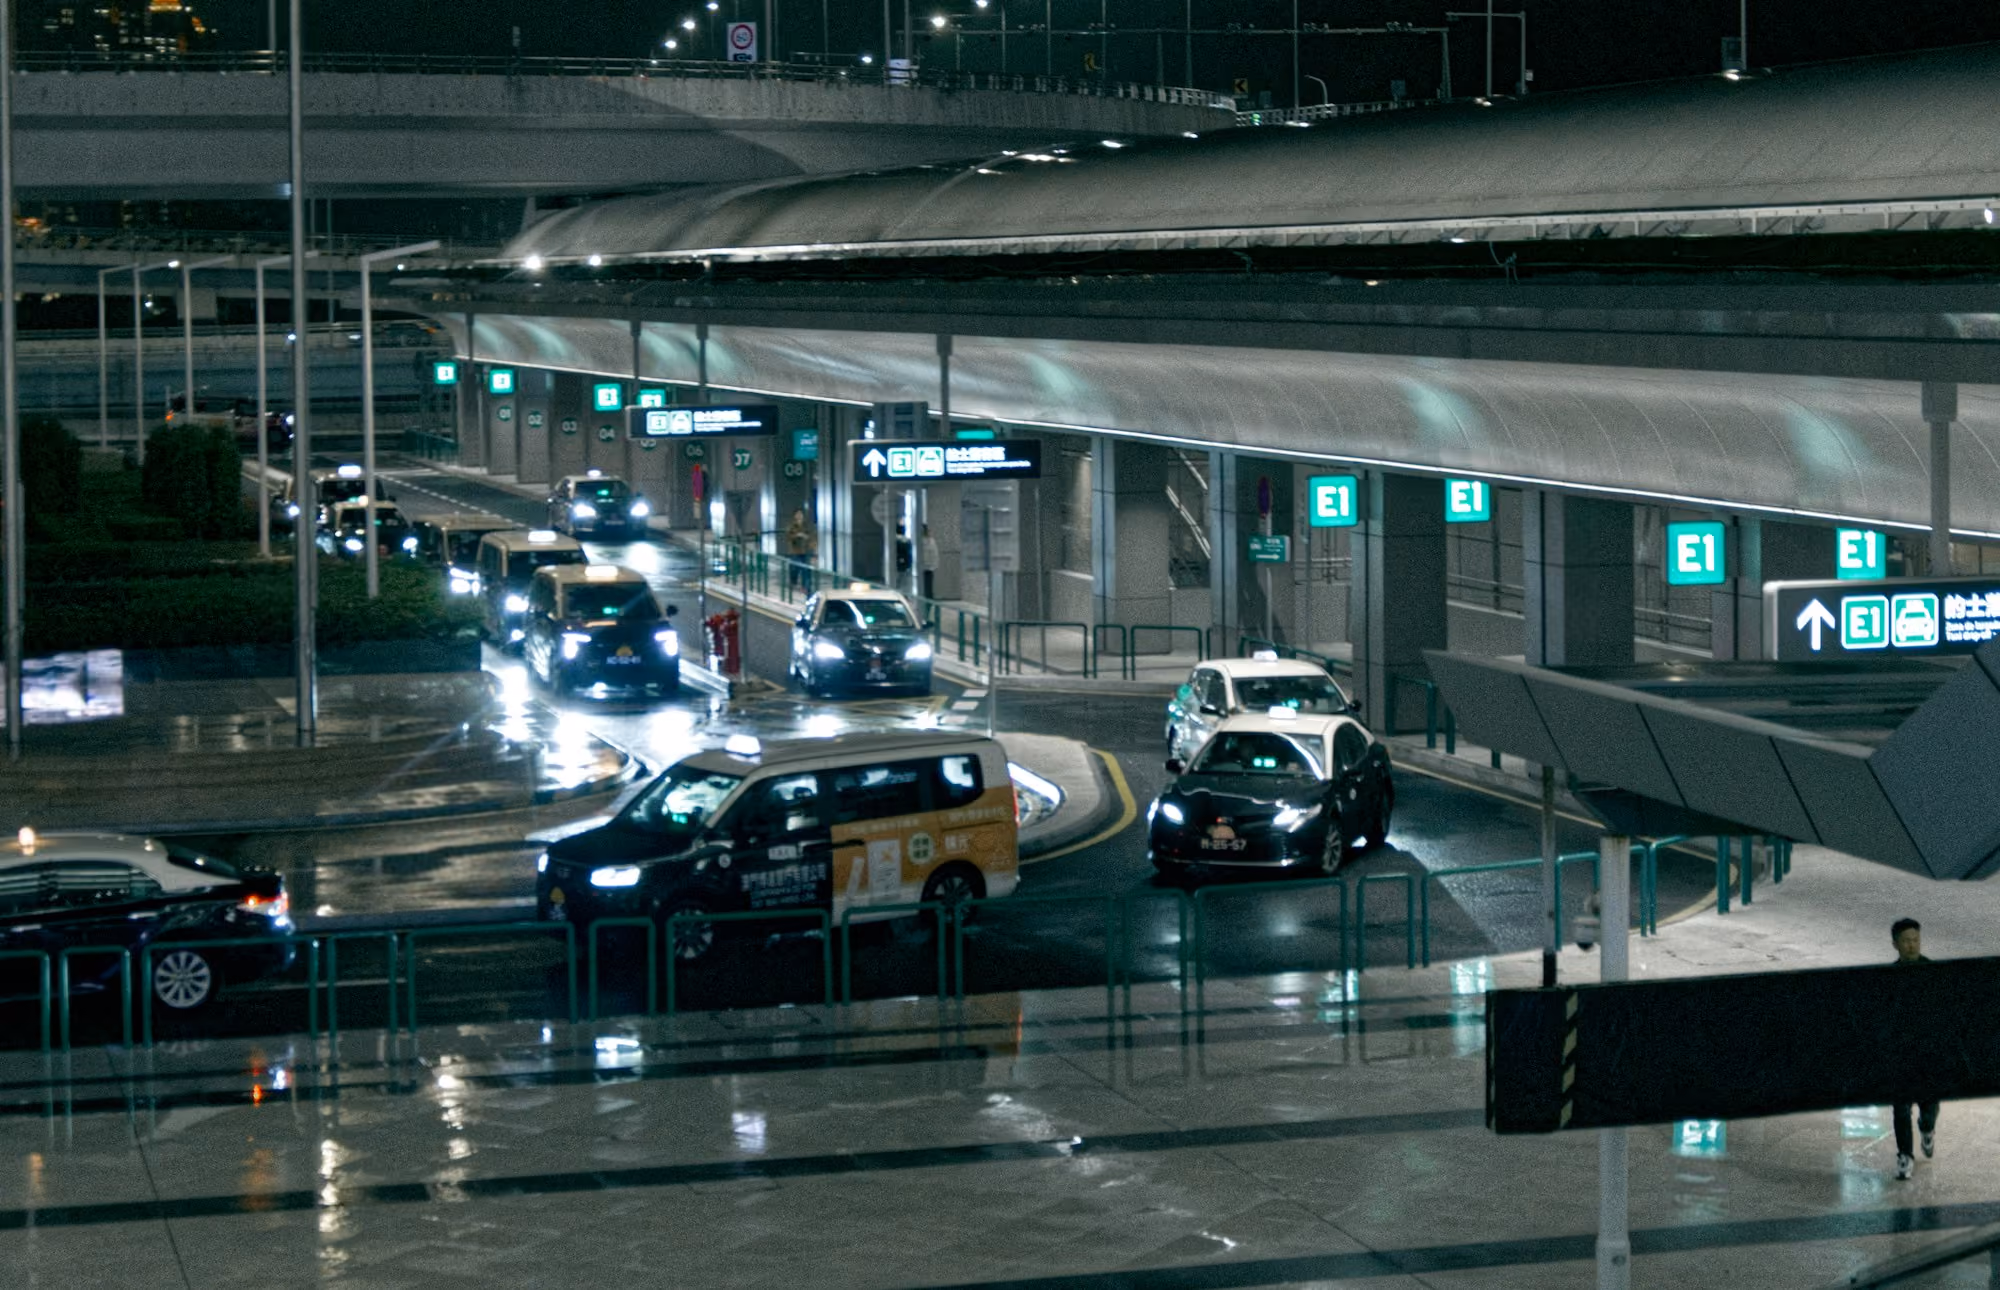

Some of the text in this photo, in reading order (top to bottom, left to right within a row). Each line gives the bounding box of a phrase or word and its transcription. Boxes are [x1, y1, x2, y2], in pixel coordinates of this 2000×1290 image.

[528, 415, 542, 425] 02
[562, 421, 577, 431] 03
[599, 428, 615, 440] 04
[1317, 485, 1349, 516] E1
[1451, 481, 1482, 512] E1
[1677, 534, 1715, 571] E1
[1839, 530, 1876, 568] E1
[1850, 606, 1881, 638] E1
